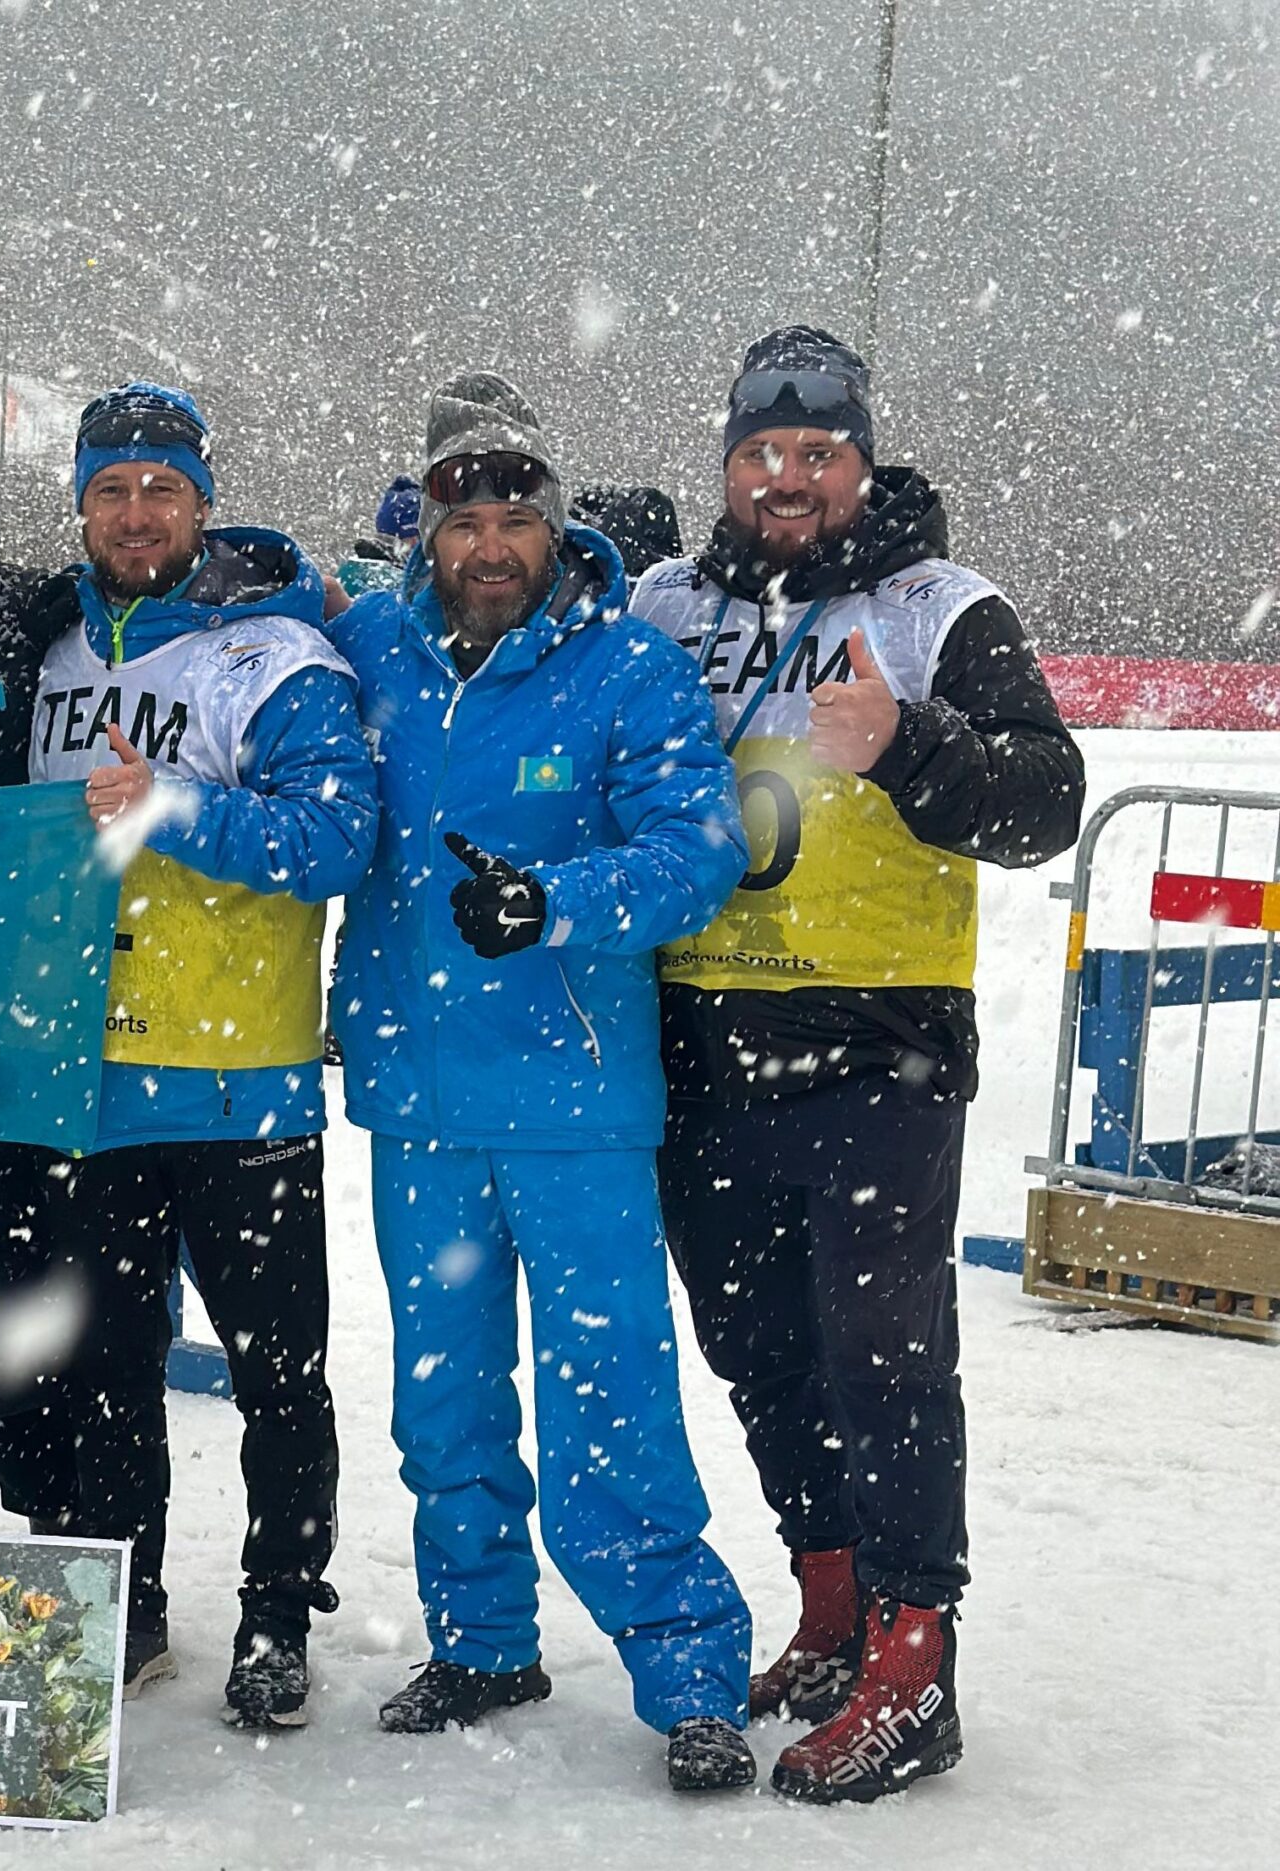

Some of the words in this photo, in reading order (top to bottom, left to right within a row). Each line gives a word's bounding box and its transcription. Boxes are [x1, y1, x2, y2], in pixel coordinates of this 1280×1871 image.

[43, 686, 188, 765] TEAM
[239, 1144, 307, 1168] NORDSK
[831, 1683, 944, 1785] alpina
